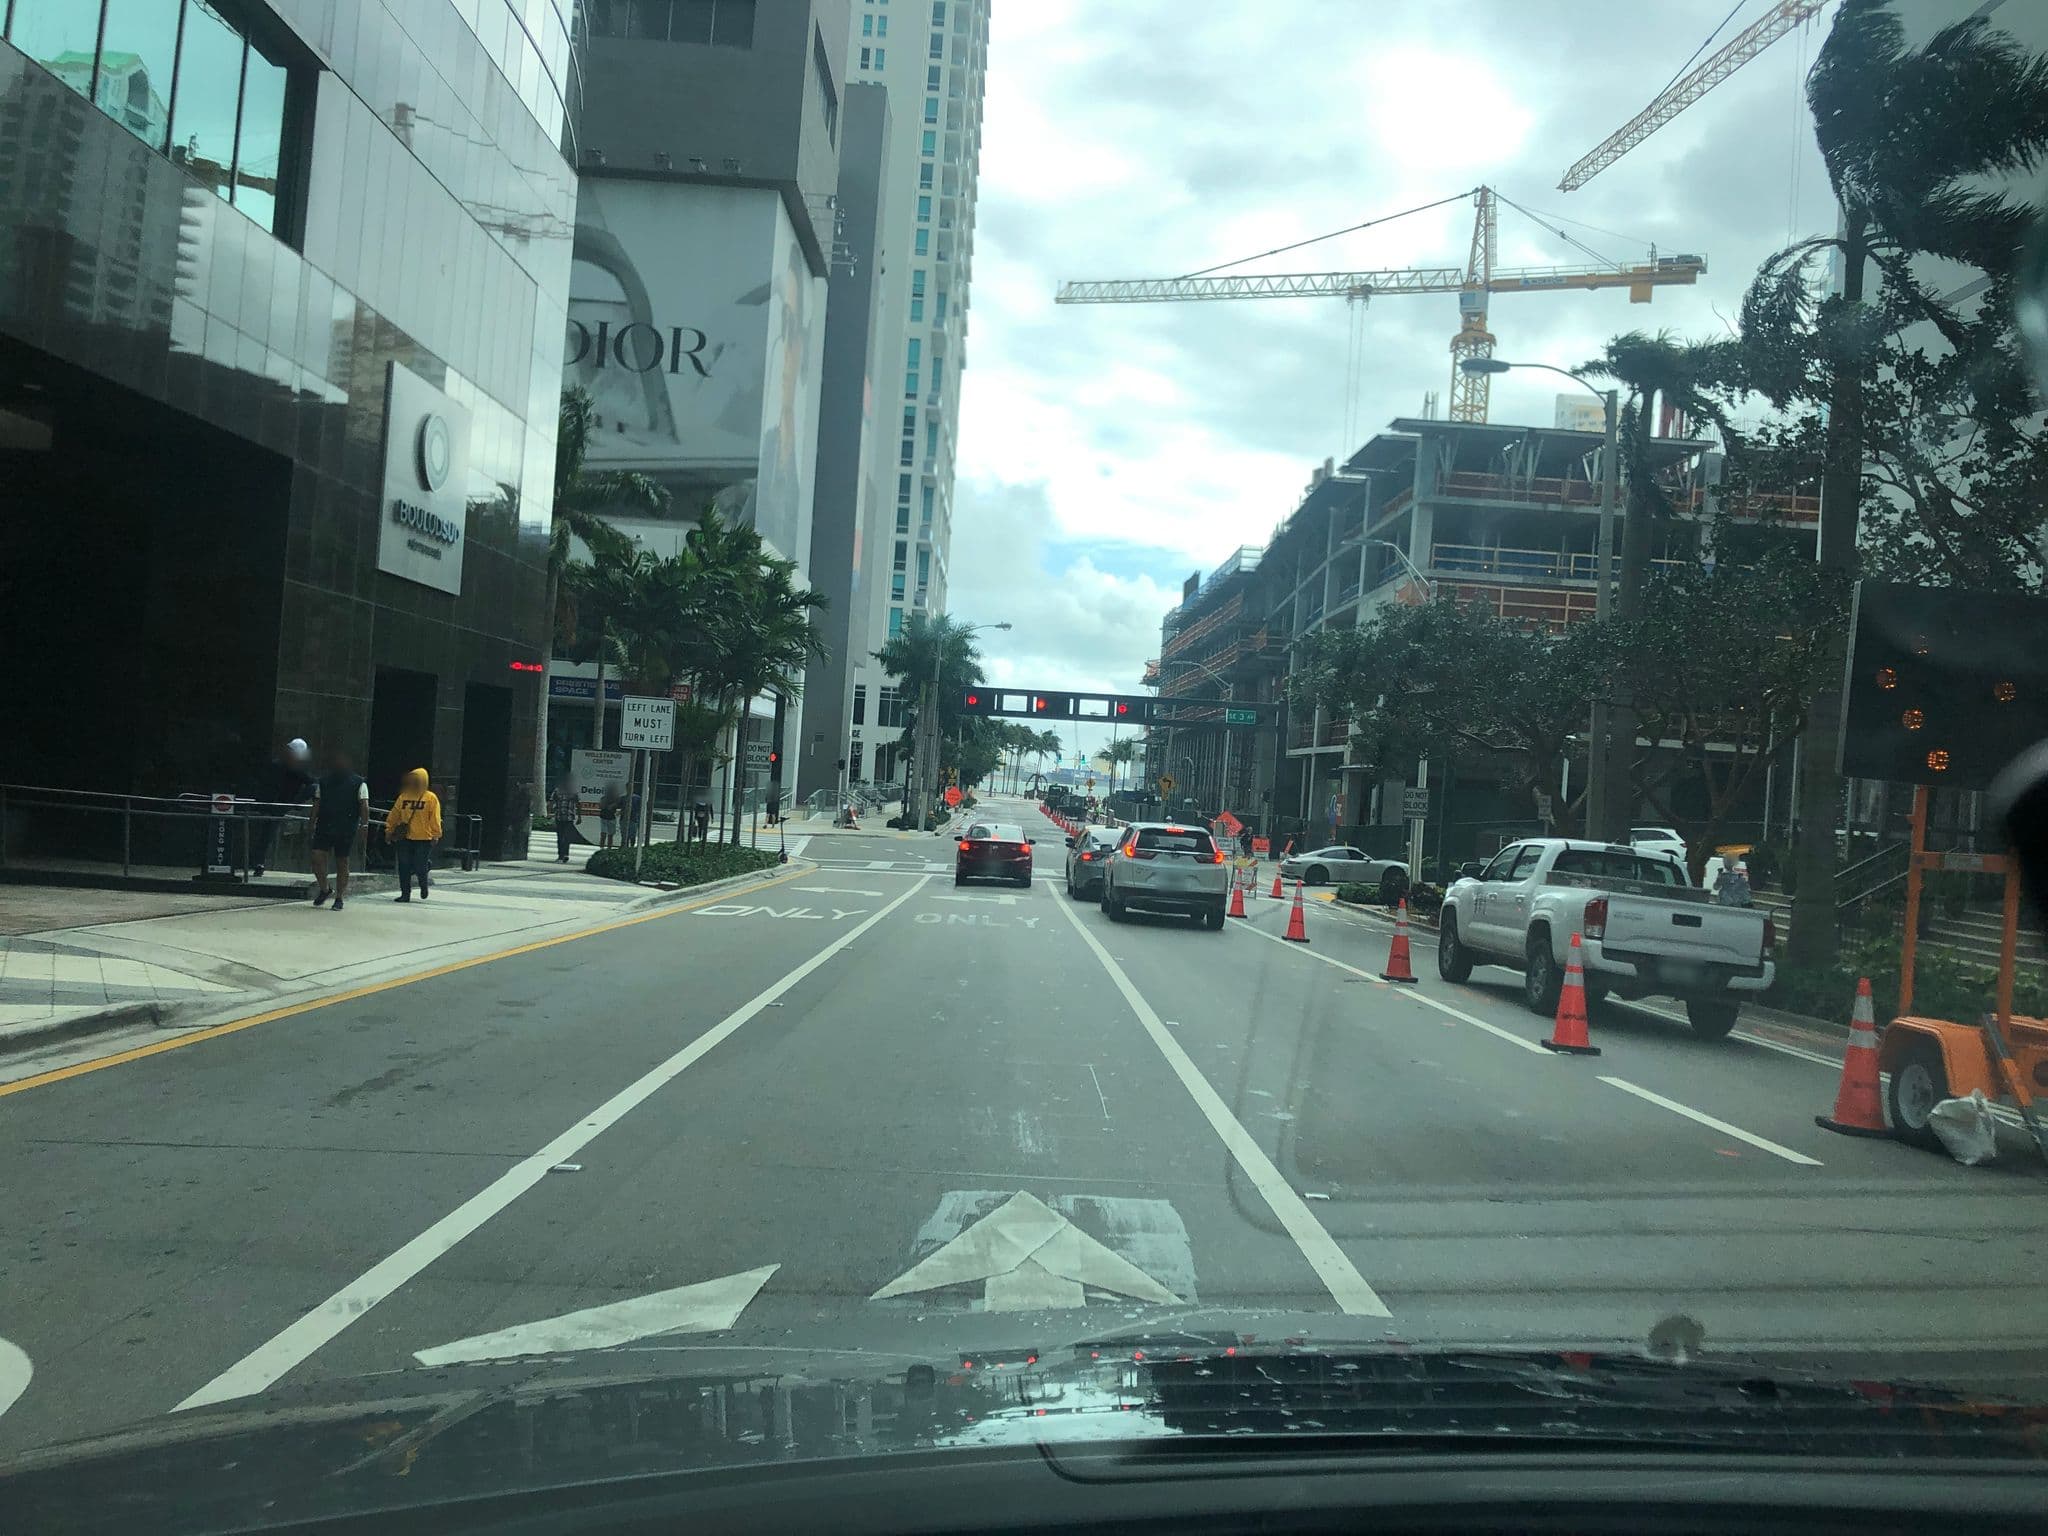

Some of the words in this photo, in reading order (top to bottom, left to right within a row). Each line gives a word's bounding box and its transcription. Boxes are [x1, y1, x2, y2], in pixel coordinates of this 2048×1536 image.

[555, 687, 589, 695] SPACE
[627, 703, 646, 712] LEFT
[651, 705, 672, 714] LANE
[634, 717, 662, 729] MUST
[624, 732, 644, 742] TURN
[650, 734, 669, 744] LEFT
[690, 905, 869, 920] ONLY
[913, 912, 1040, 929] ONLY
